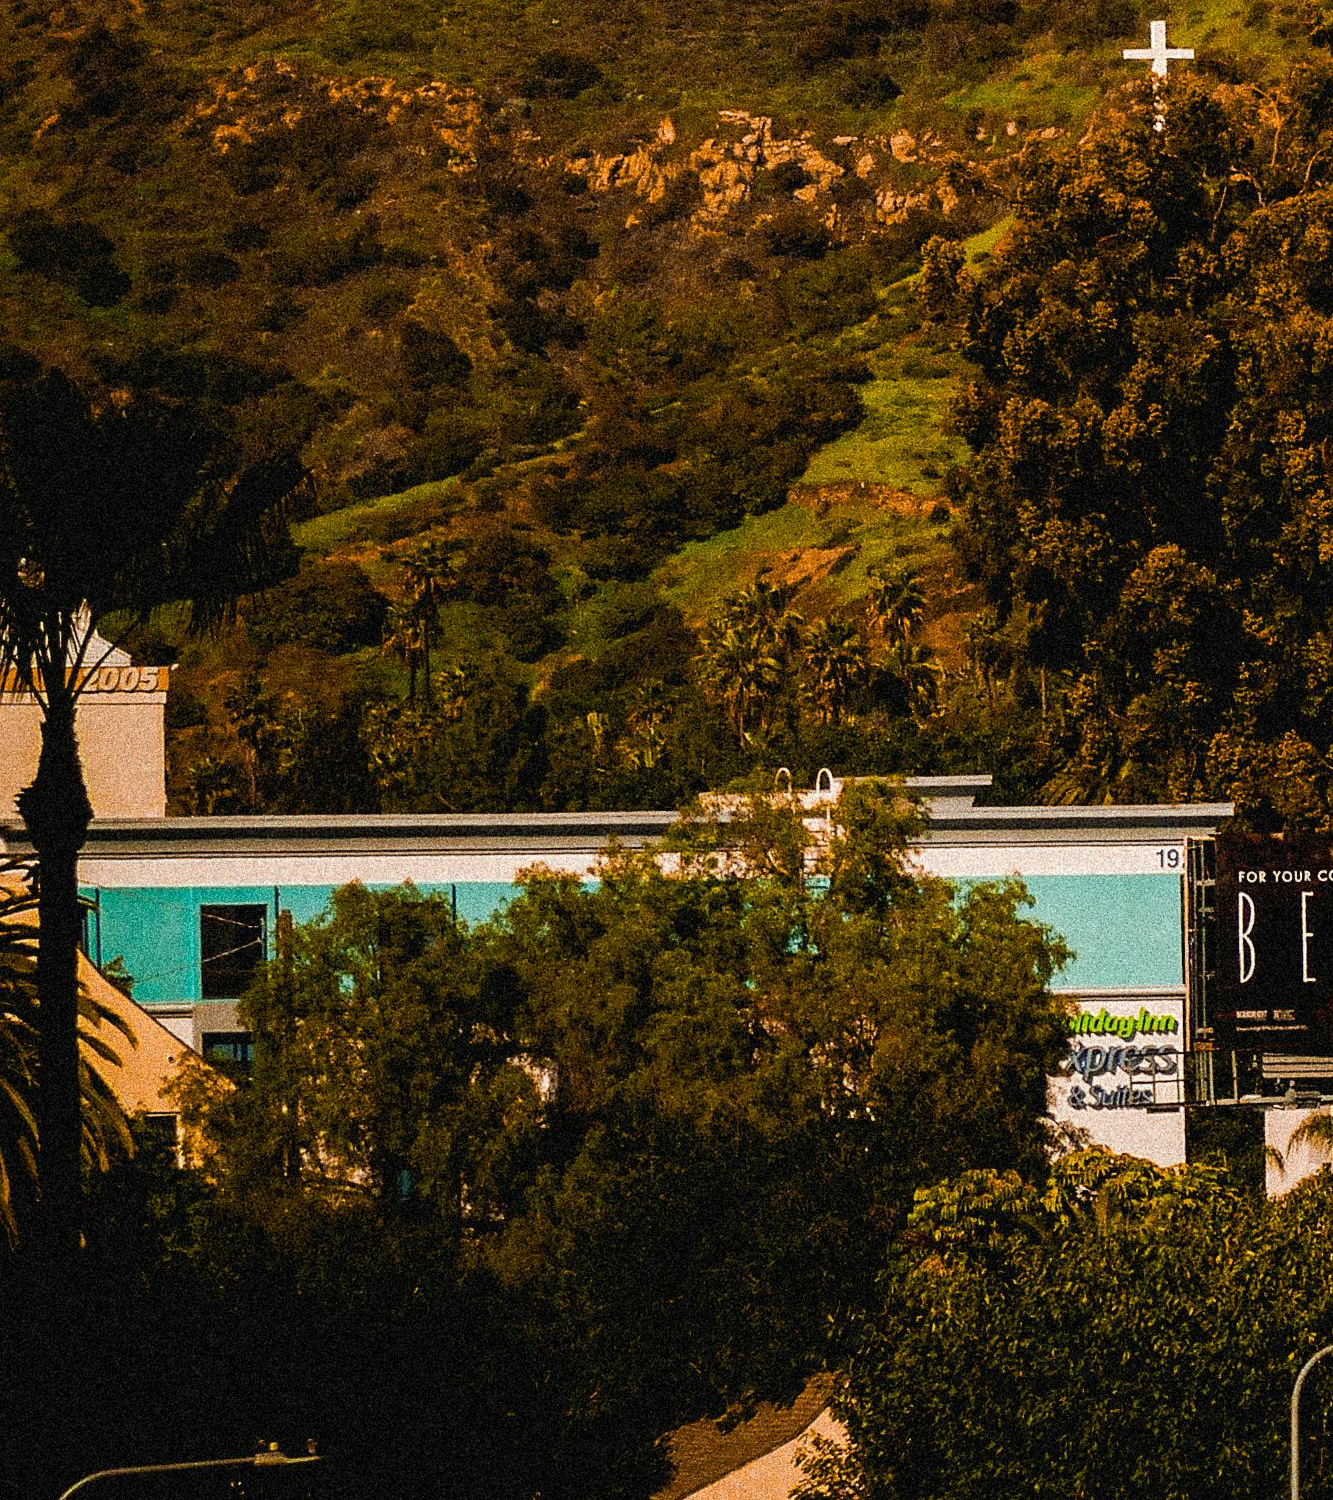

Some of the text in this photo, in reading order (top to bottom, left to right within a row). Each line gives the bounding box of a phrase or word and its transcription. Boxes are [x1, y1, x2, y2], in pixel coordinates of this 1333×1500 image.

[1156, 849, 1179, 868] 19
[1238, 870, 1266, 883] FOR
[1273, 870, 1312, 882] YOUR
[1070, 1006, 1176, 1038] liday Inn
[1066, 1046, 1178, 1083] xpress
[1068, 1086, 1085, 1109] &
